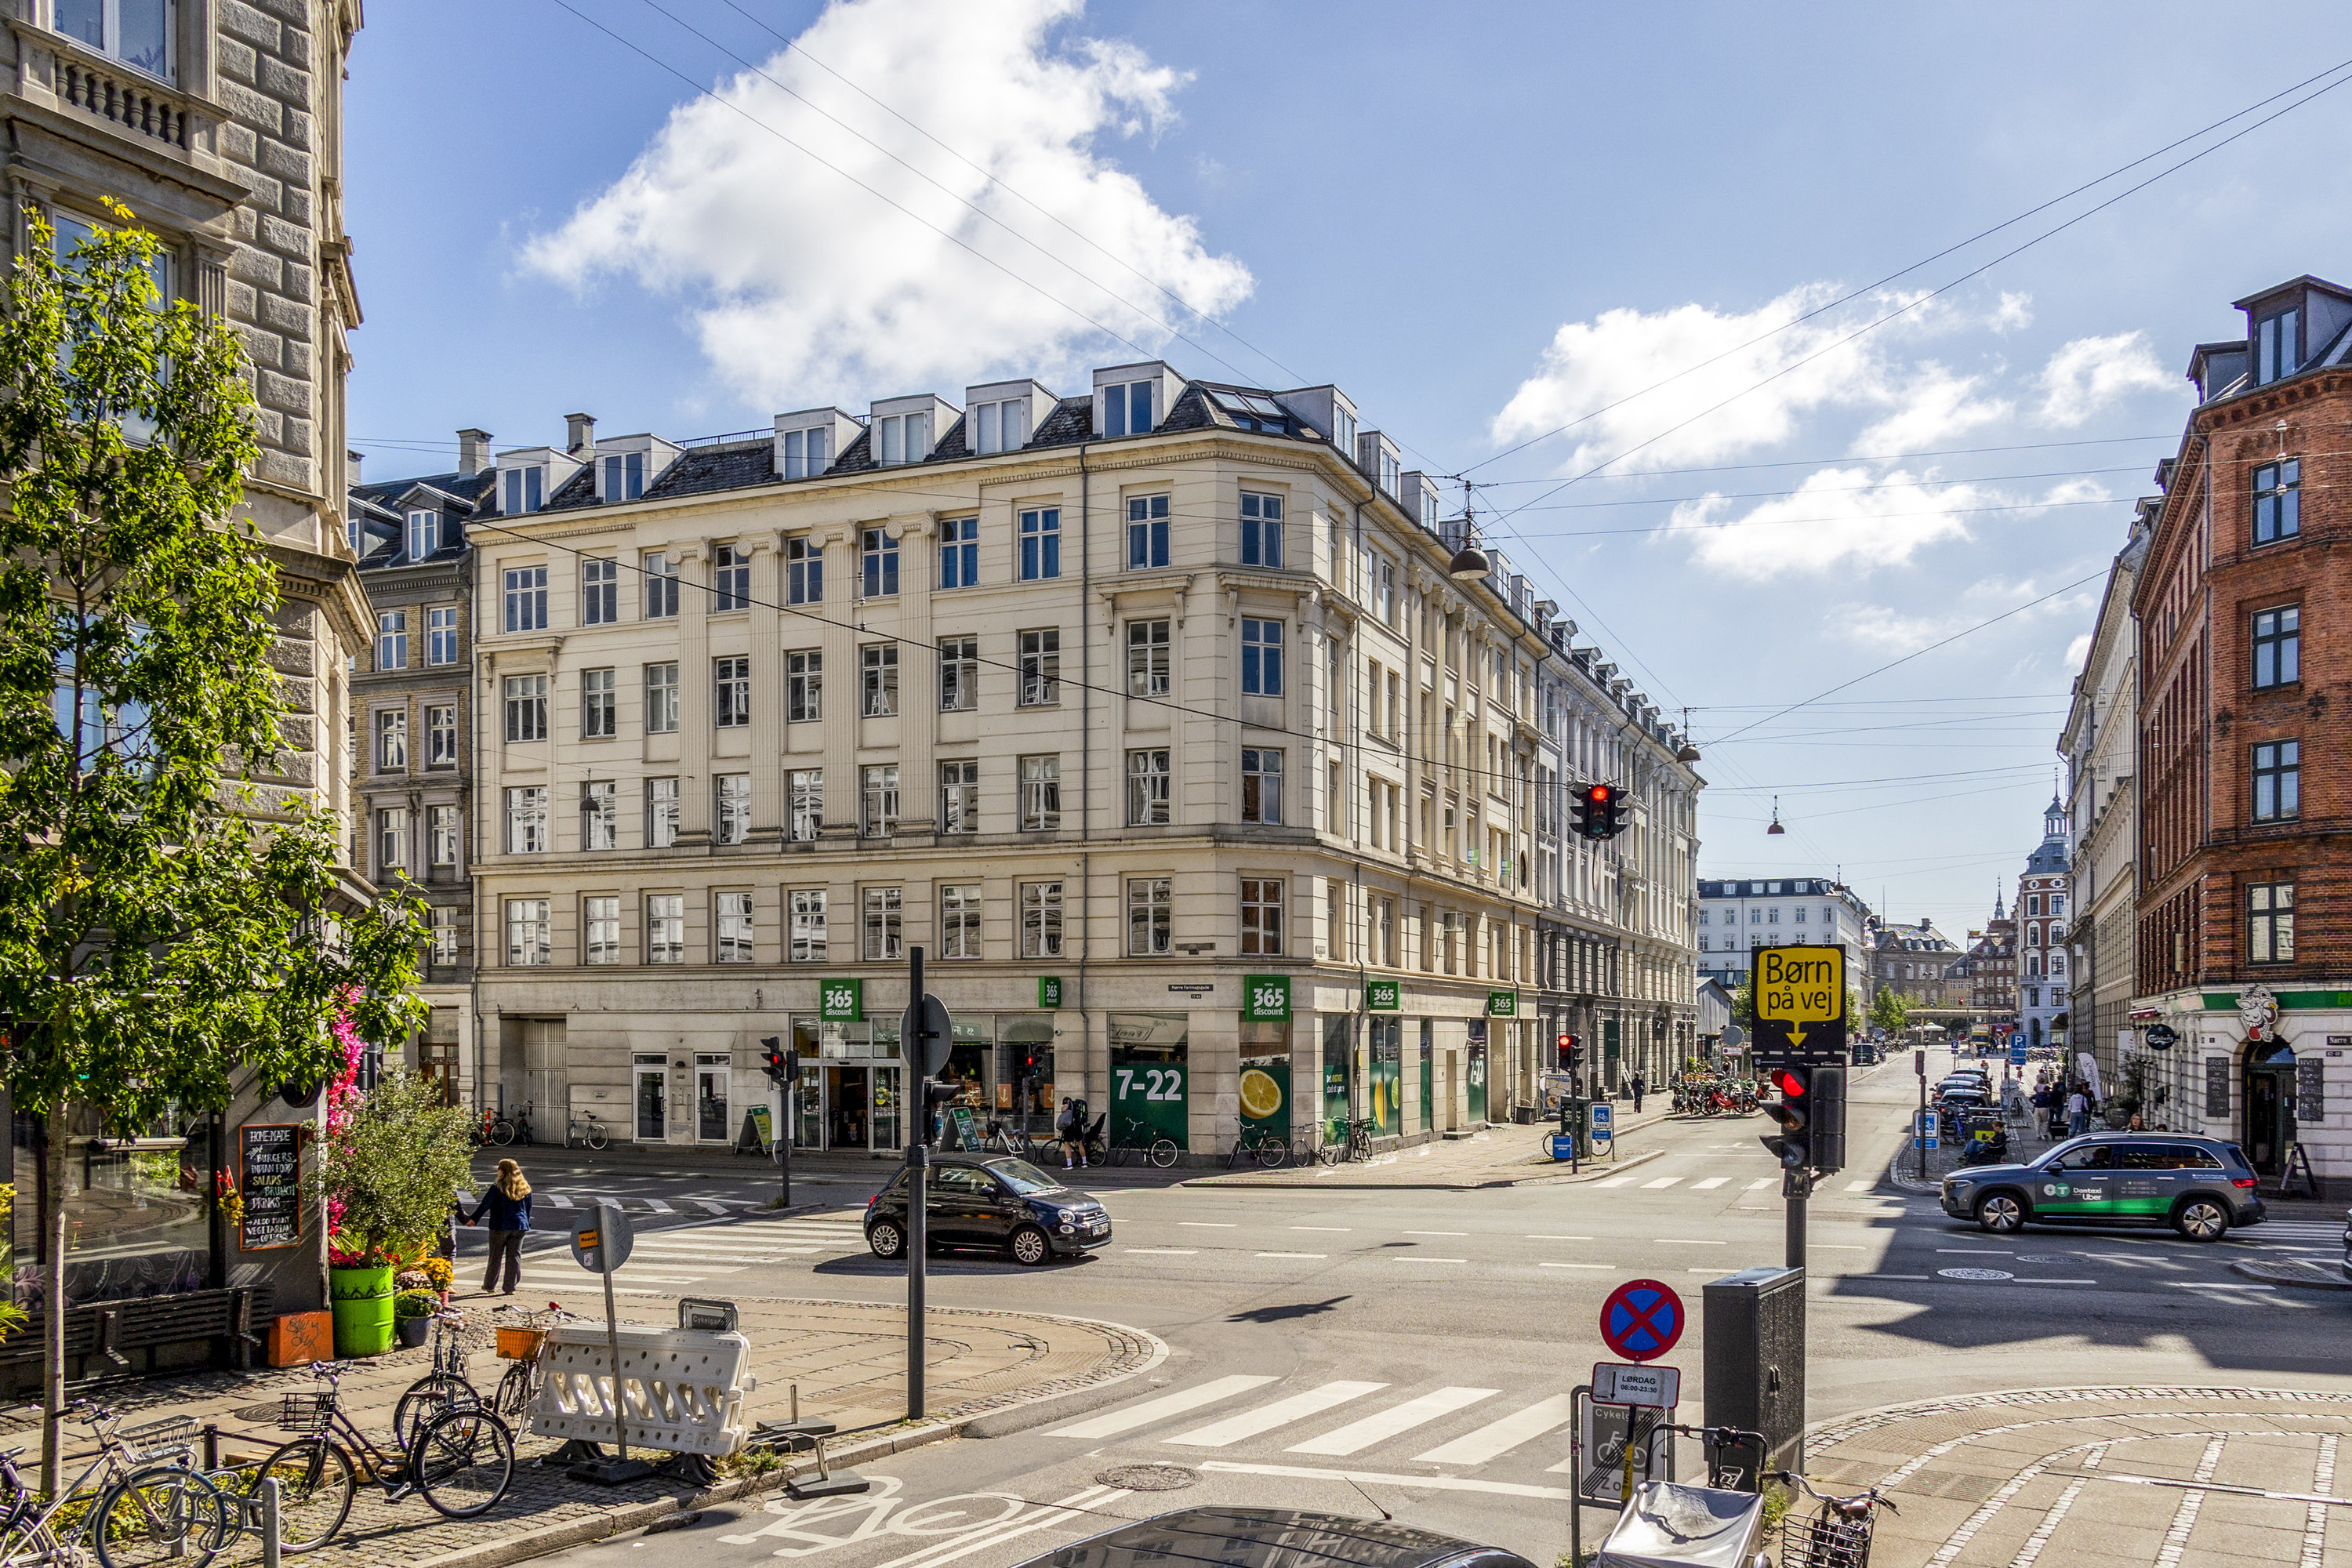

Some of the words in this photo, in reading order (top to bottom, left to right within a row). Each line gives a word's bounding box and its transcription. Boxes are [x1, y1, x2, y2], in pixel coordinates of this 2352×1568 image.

[1767, 953, 1831, 984] Børn
[1046, 985, 1058, 997] 365
[1374, 989, 1394, 1001] 365
[826, 989, 853, 1008] 365
[1254, 988, 1284, 1007] 365
[1494, 998, 1511, 1008] 365
[1768, 985, 1795, 1017] på
[1800, 985, 1831, 1017] vej
[2015, 1036, 2023, 1046] P
[2147, 1034, 2174, 1043] Carlsberg
[1116, 1069, 1181, 1101] 7-22
[250, 1130, 291, 1142] HOME-MADE
[252, 1175, 281, 1185] SALADS
[264, 1185, 295, 1196] BRUNCH
[250, 1196, 281, 1210] DRINKS
[253, 1217, 270, 1225] ALSO
[1622, 1375, 1656, 1385] LØRDAG
[1621, 1384, 1657, 1393] 06:00-23:30
